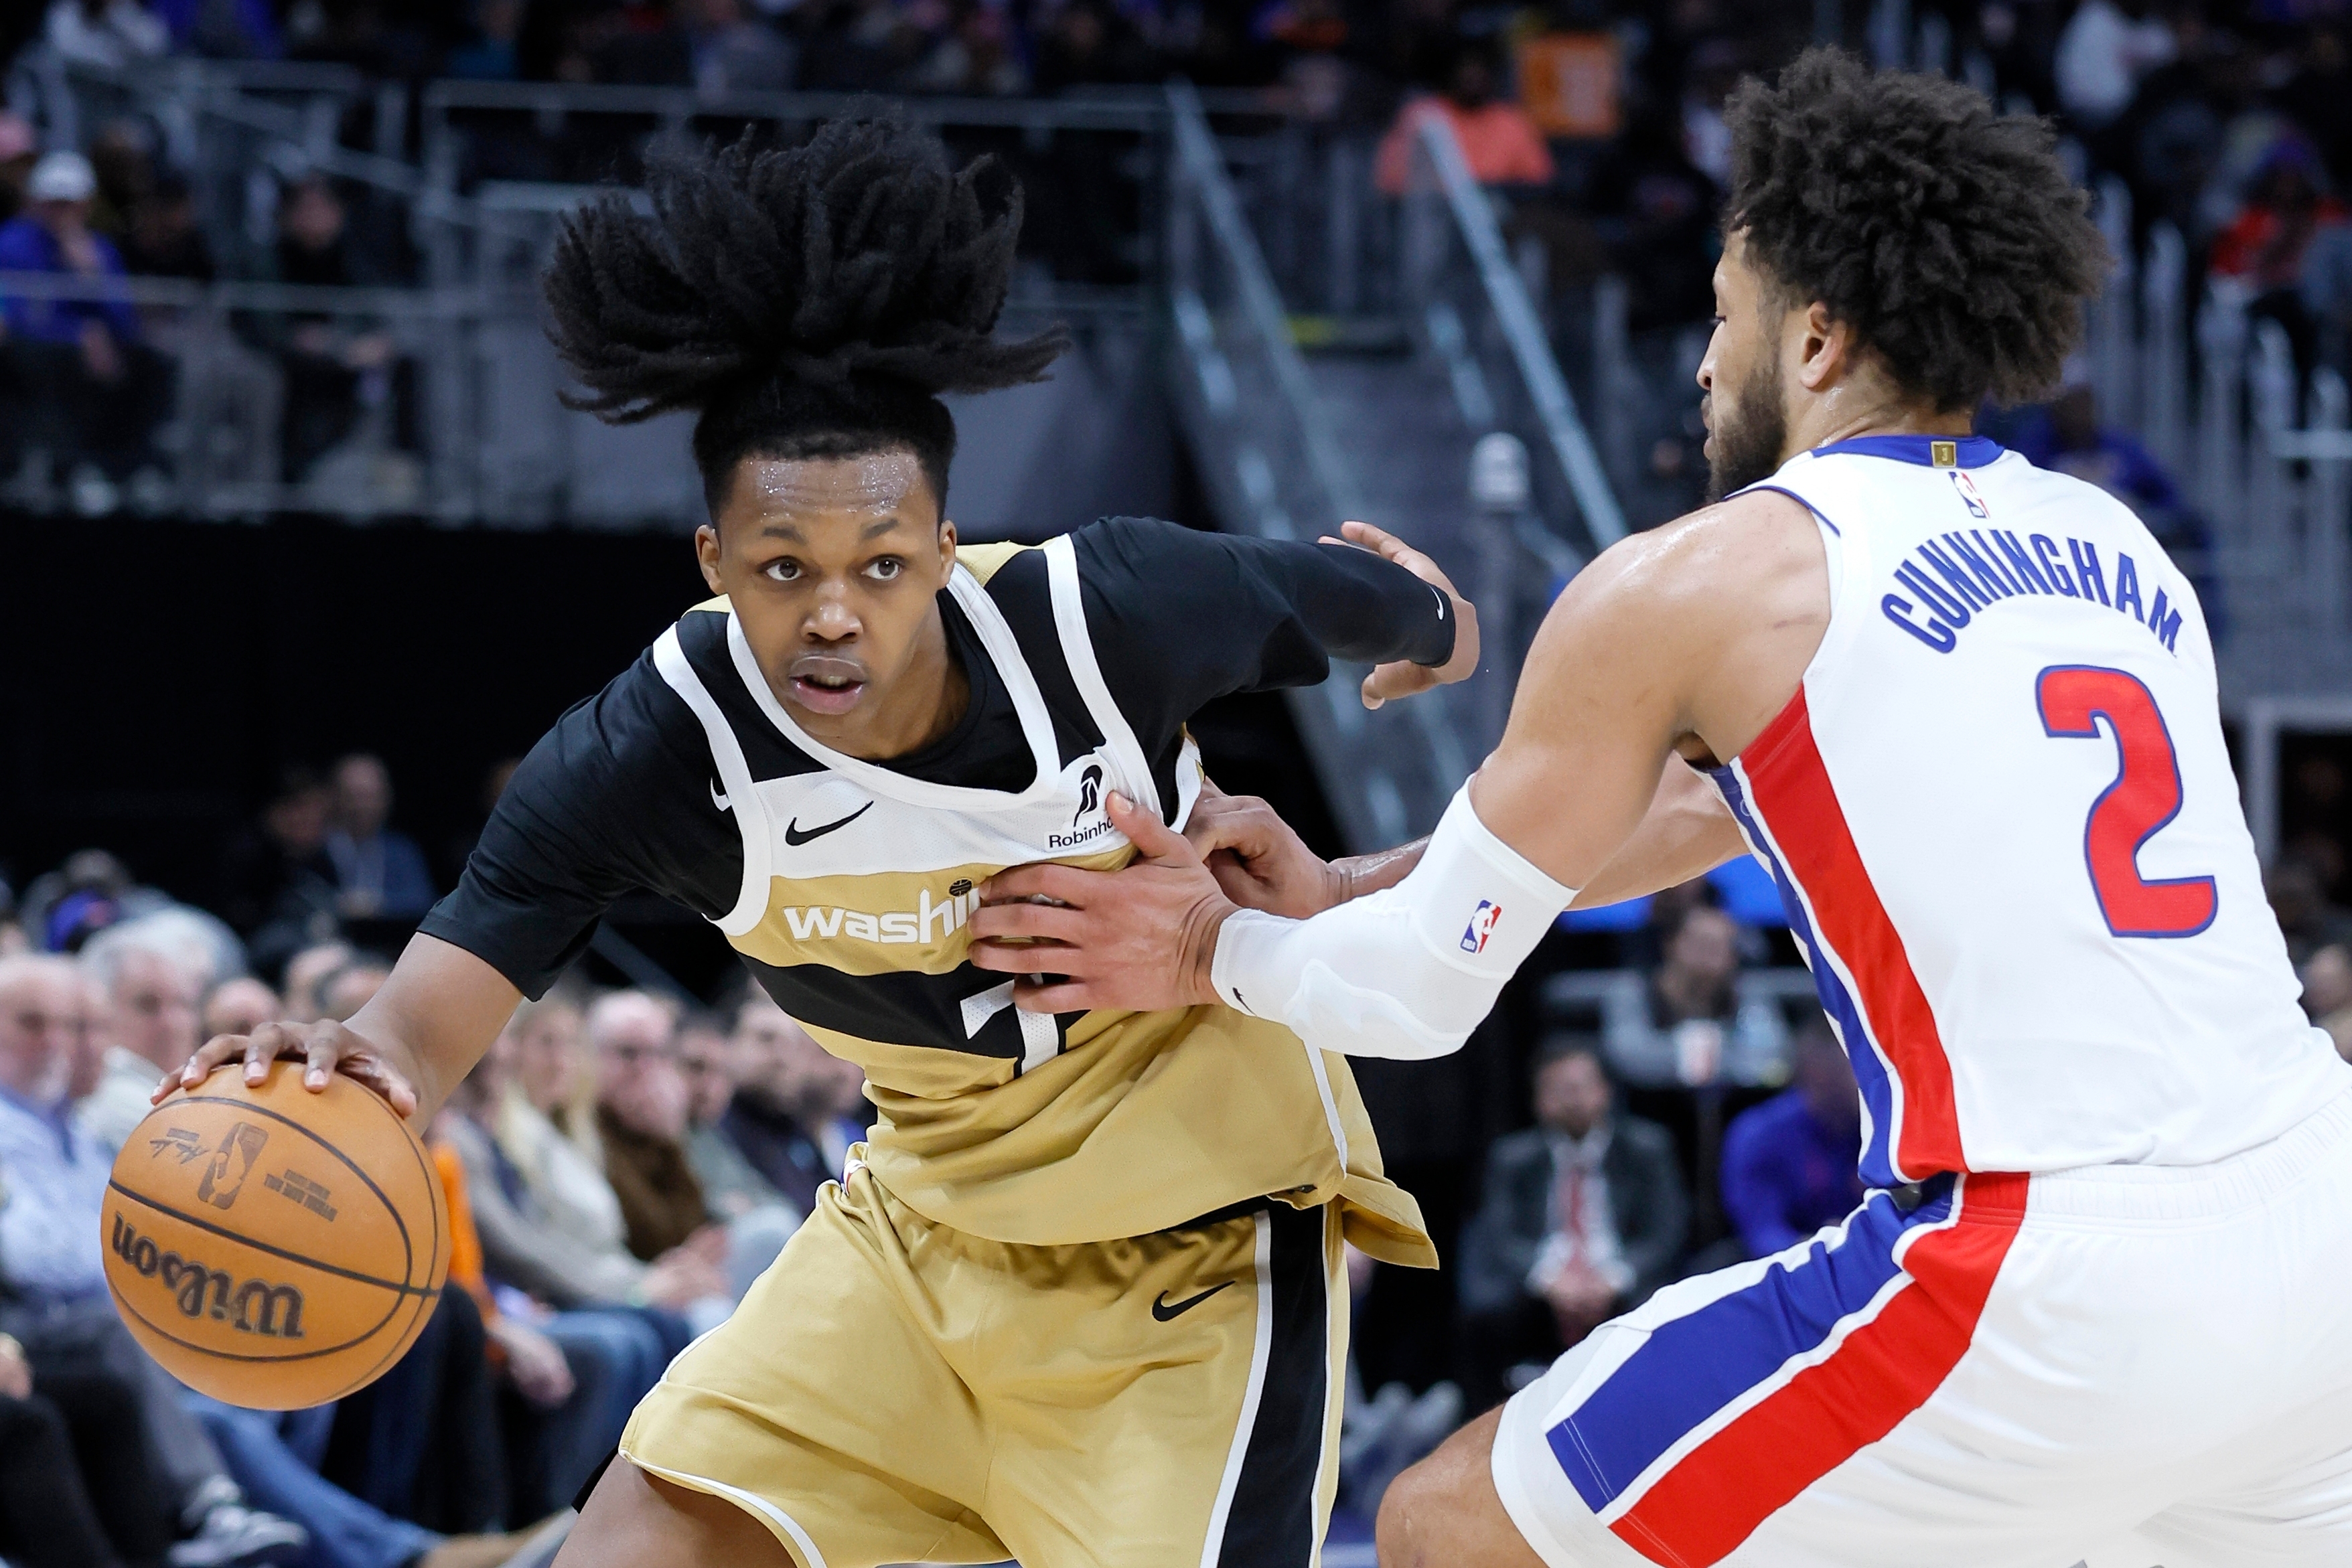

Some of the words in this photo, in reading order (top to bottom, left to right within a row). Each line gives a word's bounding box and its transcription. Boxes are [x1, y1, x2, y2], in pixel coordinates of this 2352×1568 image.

[1881, 529, 2183, 656] CUNNINGHAM
[1049, 816, 1113, 848] Robinho
[2035, 664, 2219, 938] 2
[783, 878, 980, 943] washi
[111, 1210, 306, 1339] Wilson
